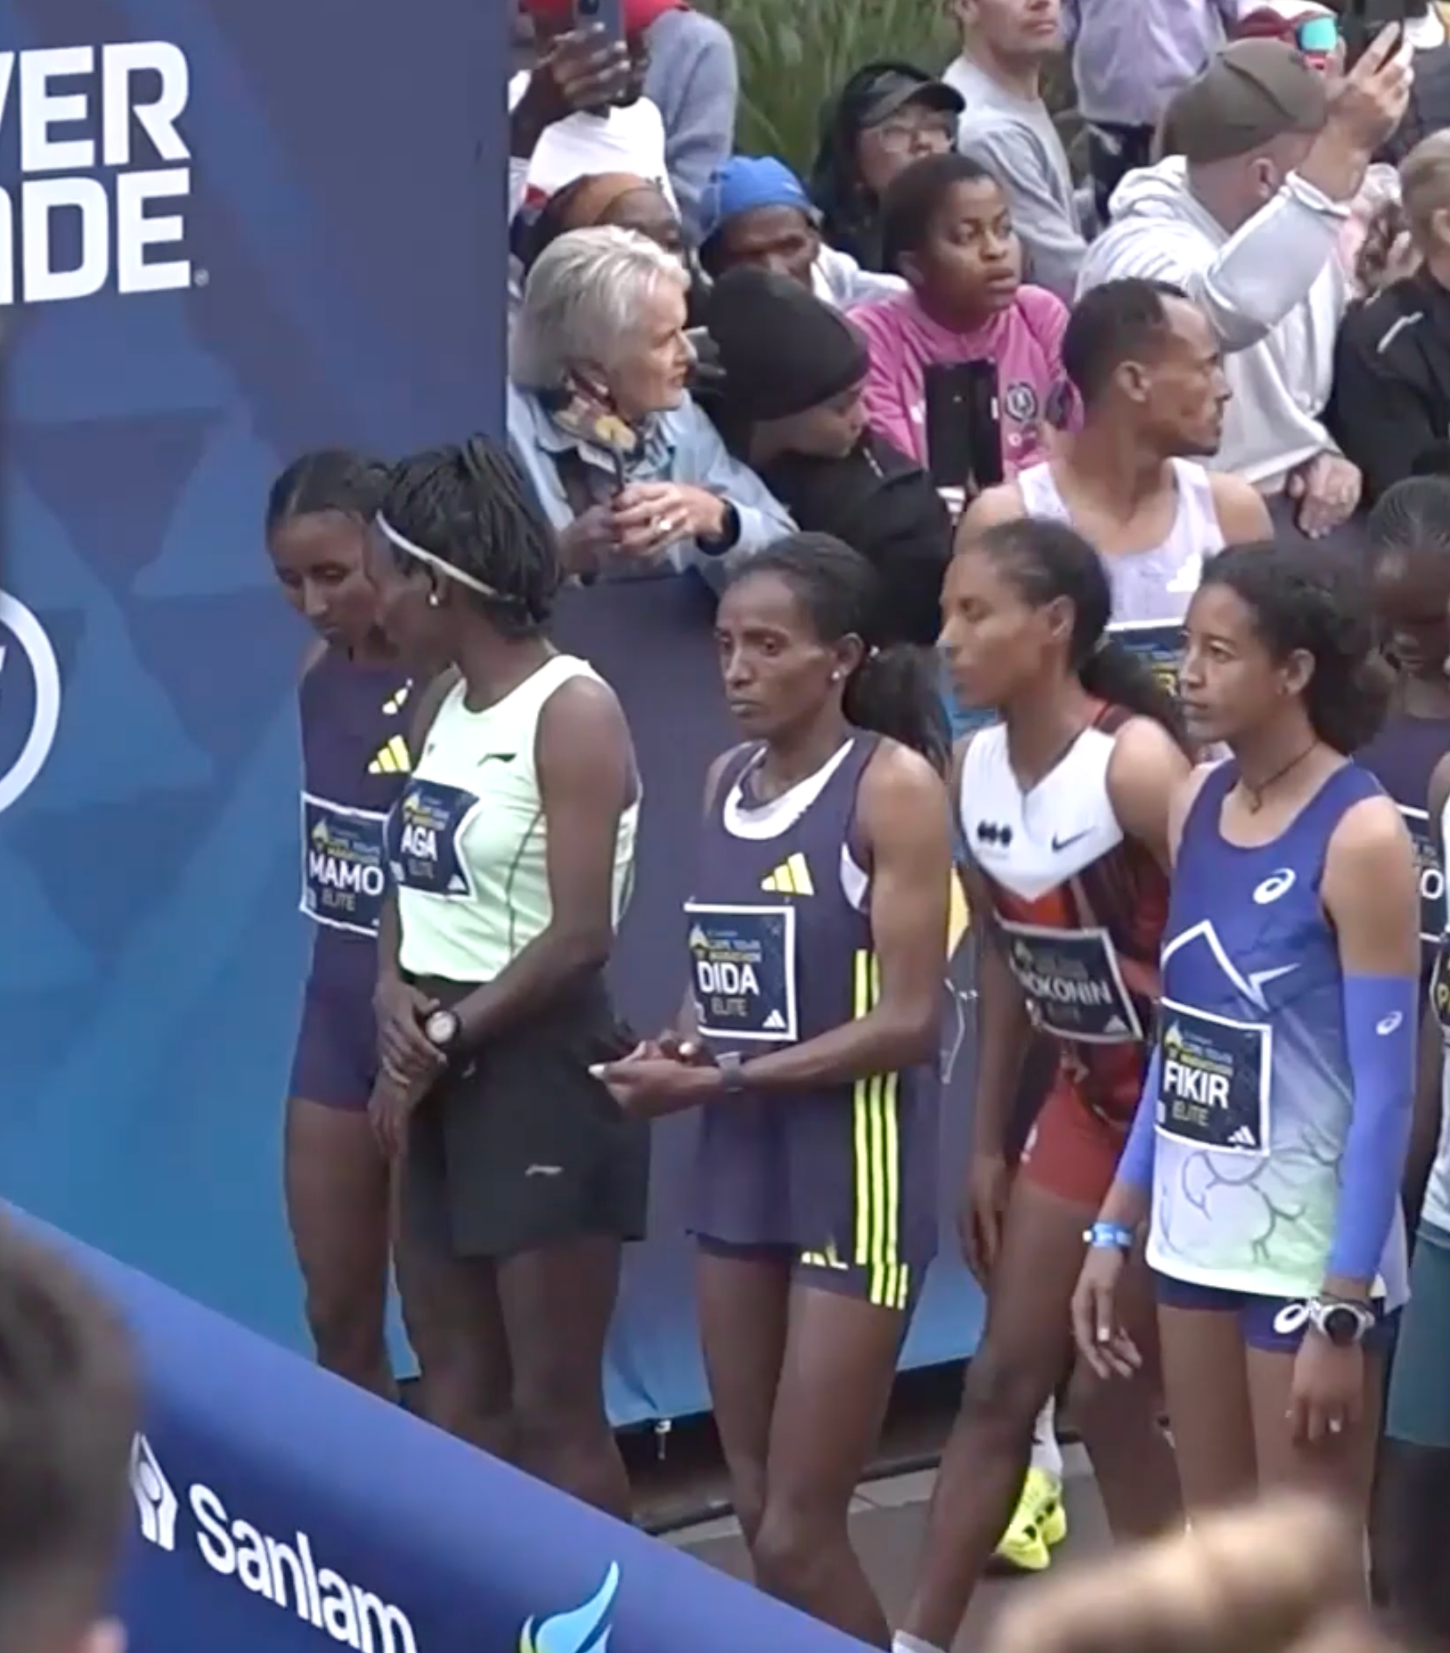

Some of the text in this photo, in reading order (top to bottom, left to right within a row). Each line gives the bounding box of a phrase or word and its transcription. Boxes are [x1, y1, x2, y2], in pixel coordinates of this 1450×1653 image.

[401, 823, 438, 861] AGA
[309, 849, 384, 896] MAMO
[697, 960, 760, 996] DIDA
[1163, 1059, 1230, 1110] FIKIR
[1172, 1099, 1210, 1127] ELITE
[189, 1483, 418, 1653] Sanlam
